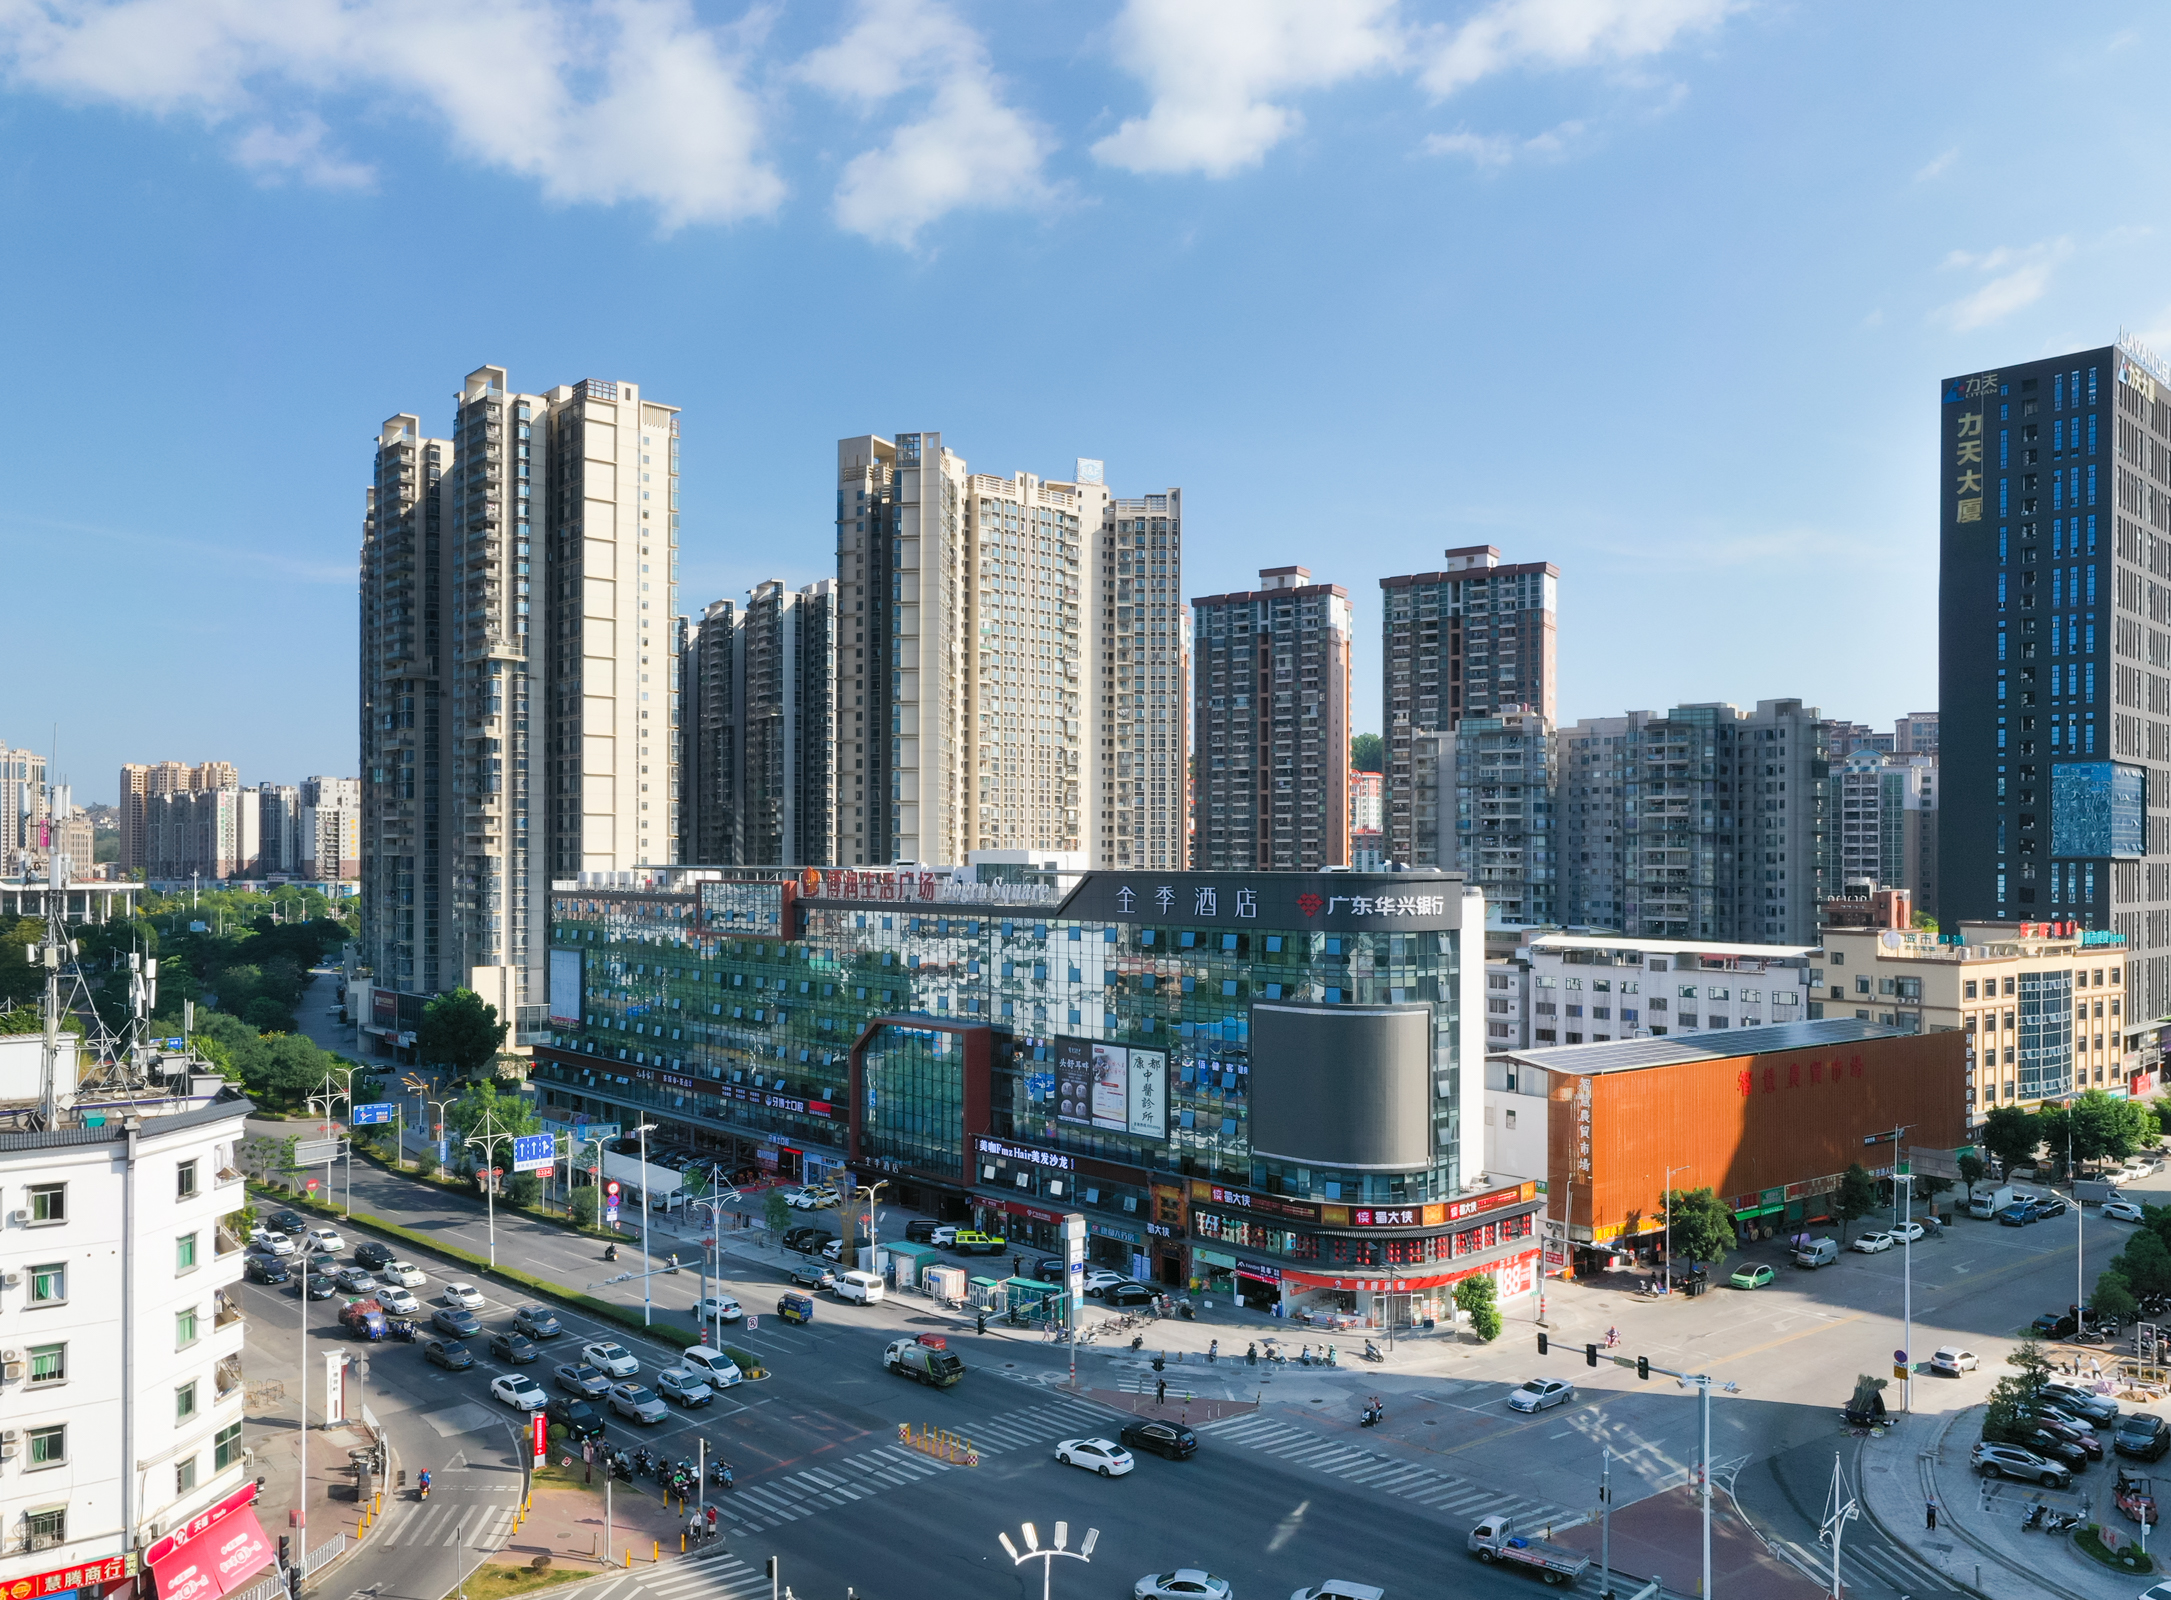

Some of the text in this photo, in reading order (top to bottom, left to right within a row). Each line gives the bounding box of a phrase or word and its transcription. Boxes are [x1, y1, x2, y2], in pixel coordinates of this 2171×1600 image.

[2120, 324, 2169, 381] LAVANDE
[1965, 373, 1998, 393] 力天
[1965, 388, 1998, 399] LITIAN
[2128, 362, 2155, 403] 力天大厦
[1956, 412, 1982, 524] 力天大厦
[827, 870, 935, 901] 博润生活广场
[991, 876, 1050, 903] Square
[1115, 885, 1259, 918] 全季酒店
[1327, 895, 1445, 917] 广东华兴银行
[771, 1096, 804, 1113] 牙博士口腔
[1224, 1190, 1251, 1207] 蜀大侠
[1459, 1202, 1478, 1216] 蜀大侠
[1375, 1210, 1413, 1224] 蜀大侠
[1147, 1222, 1170, 1238] 蜀大侠
[1503, 1263, 1521, 1297] 88
[44, 1561, 122, 1593] 慧腾商行
